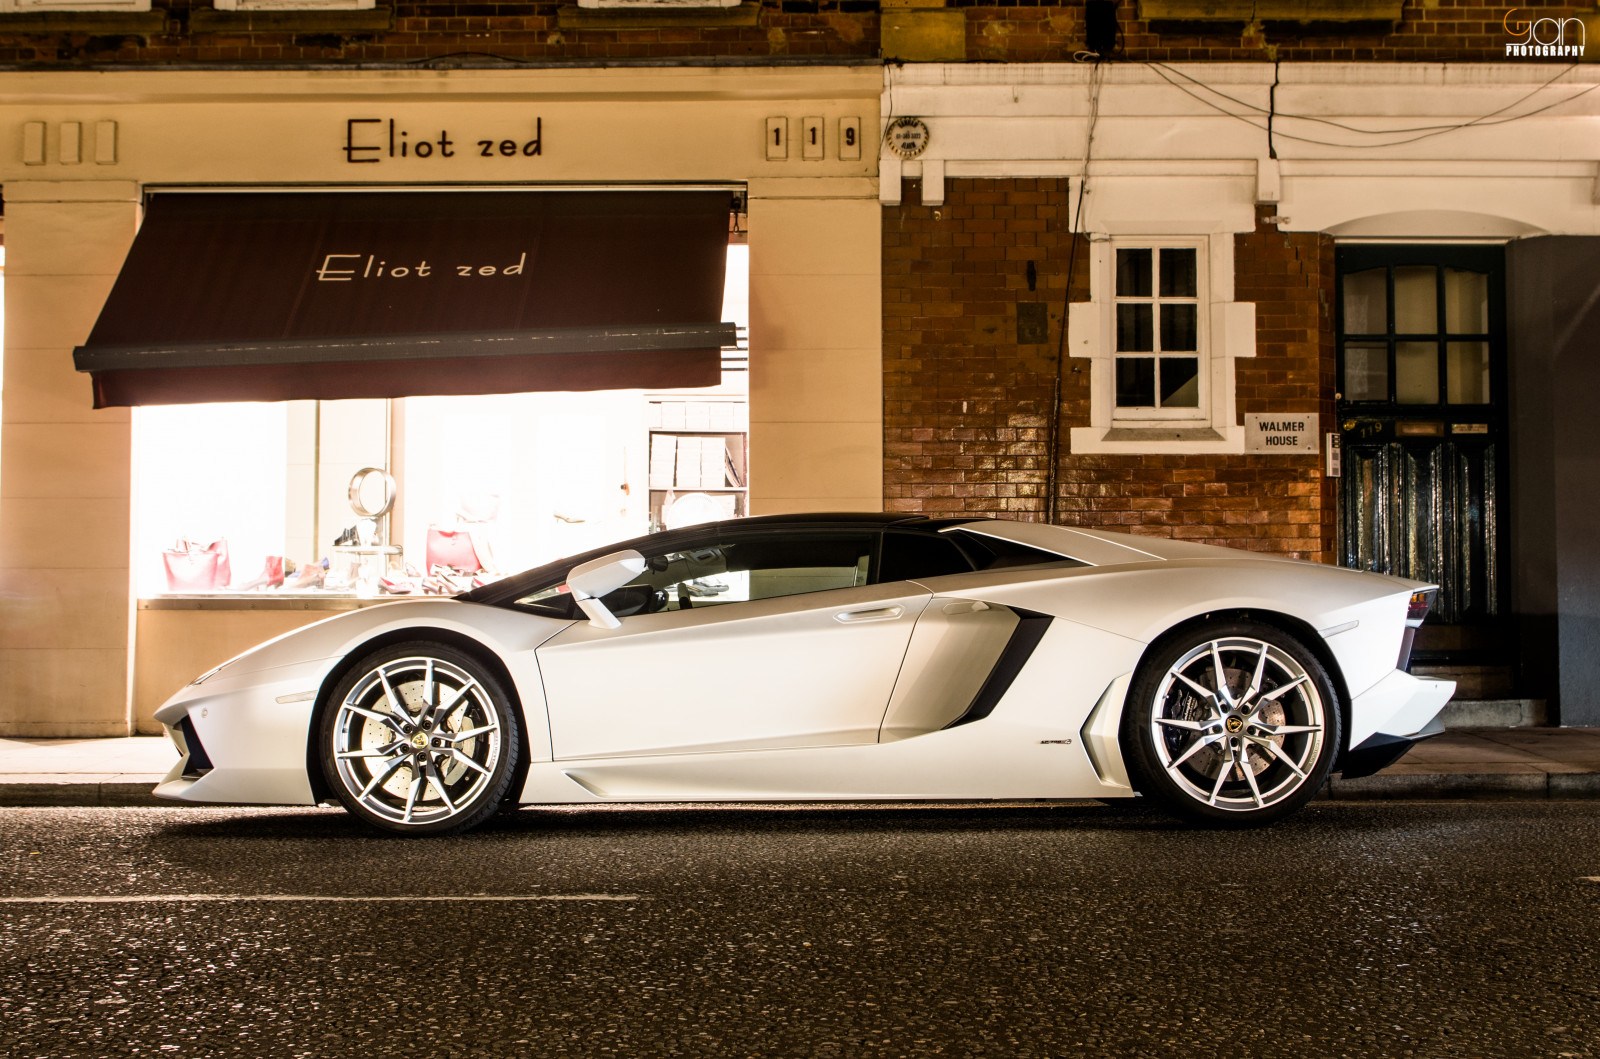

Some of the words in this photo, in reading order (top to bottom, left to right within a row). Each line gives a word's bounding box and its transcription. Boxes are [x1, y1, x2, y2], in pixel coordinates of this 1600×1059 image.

[342, 118, 455, 163] Eliot
[477, 117, 542, 157] zed
[316, 254, 431, 281] Eliot
[456, 252, 526, 276] zed
[1259, 421, 1305, 432] WALMER
[1265, 435, 1299, 446] HOUSE
